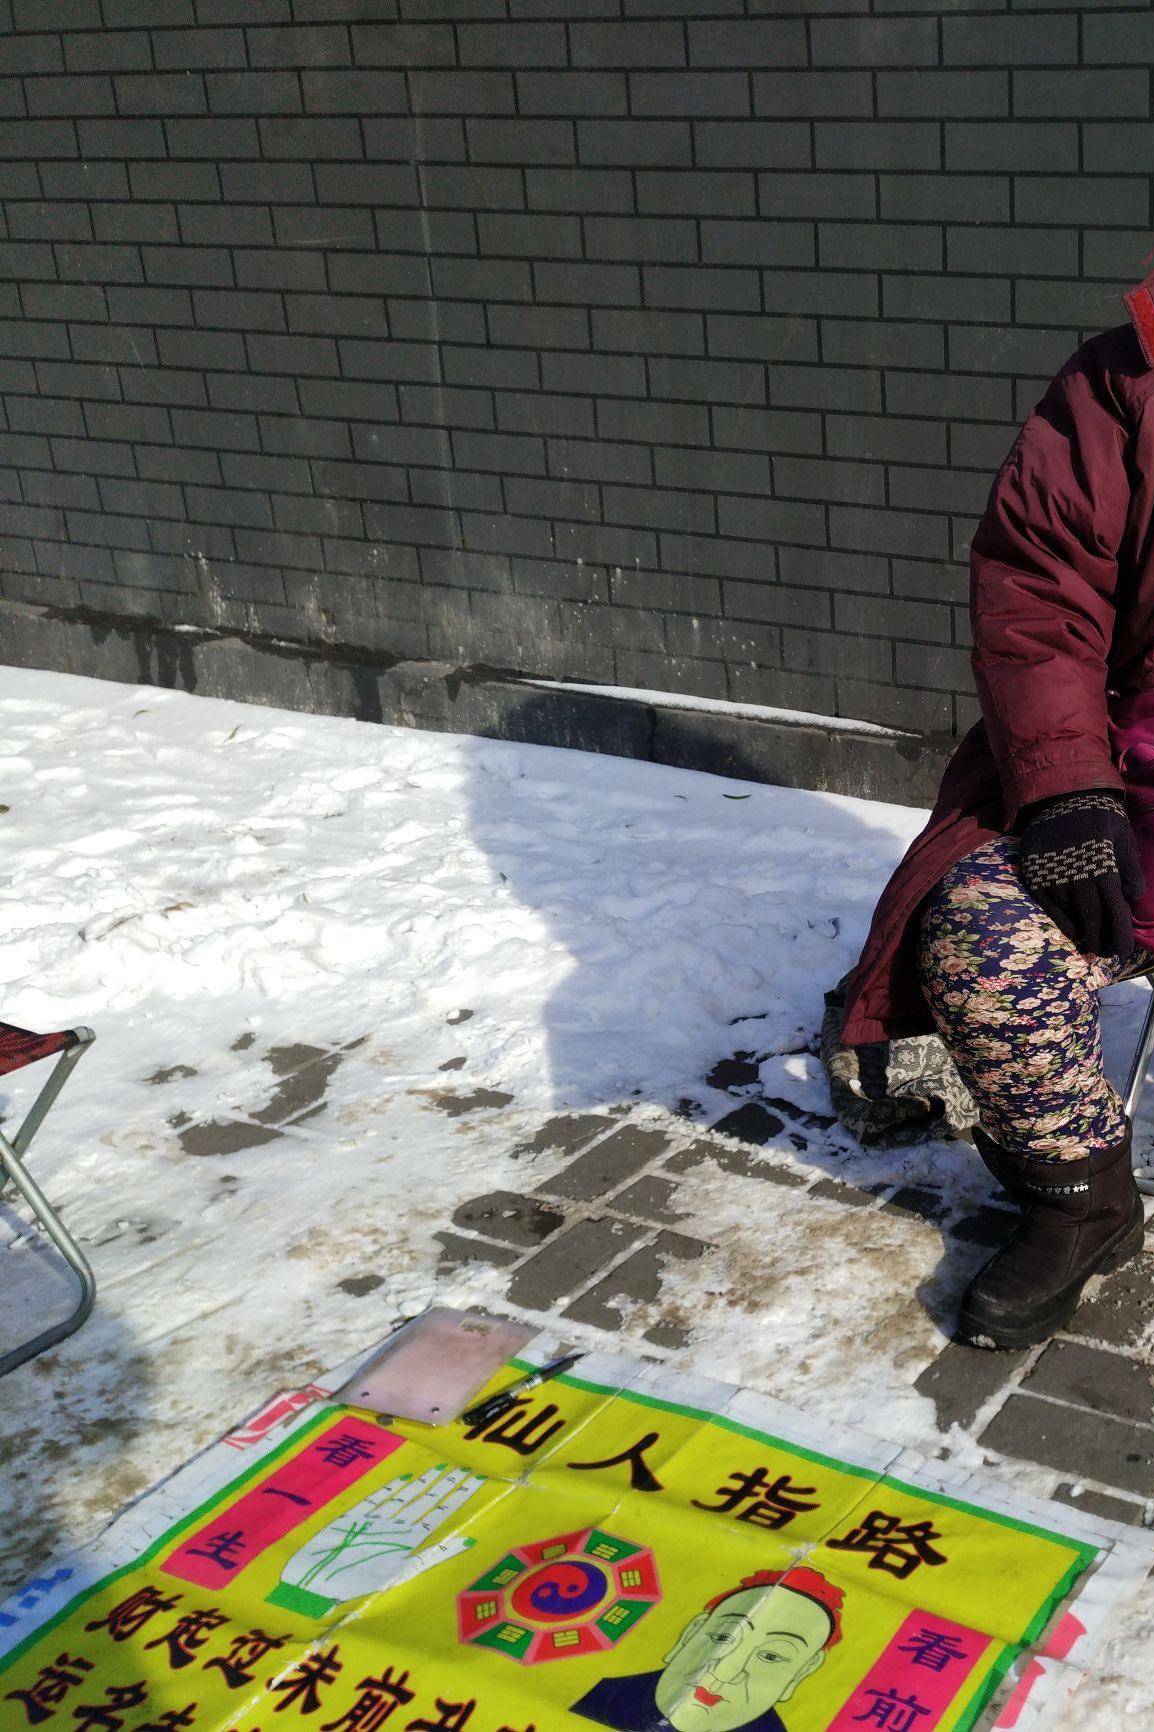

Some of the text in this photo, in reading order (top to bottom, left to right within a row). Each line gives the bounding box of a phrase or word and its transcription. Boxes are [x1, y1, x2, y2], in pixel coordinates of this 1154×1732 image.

[184, 1433, 375, 1571] 看一生
[463, 1398, 949, 1580] 仙人指路
